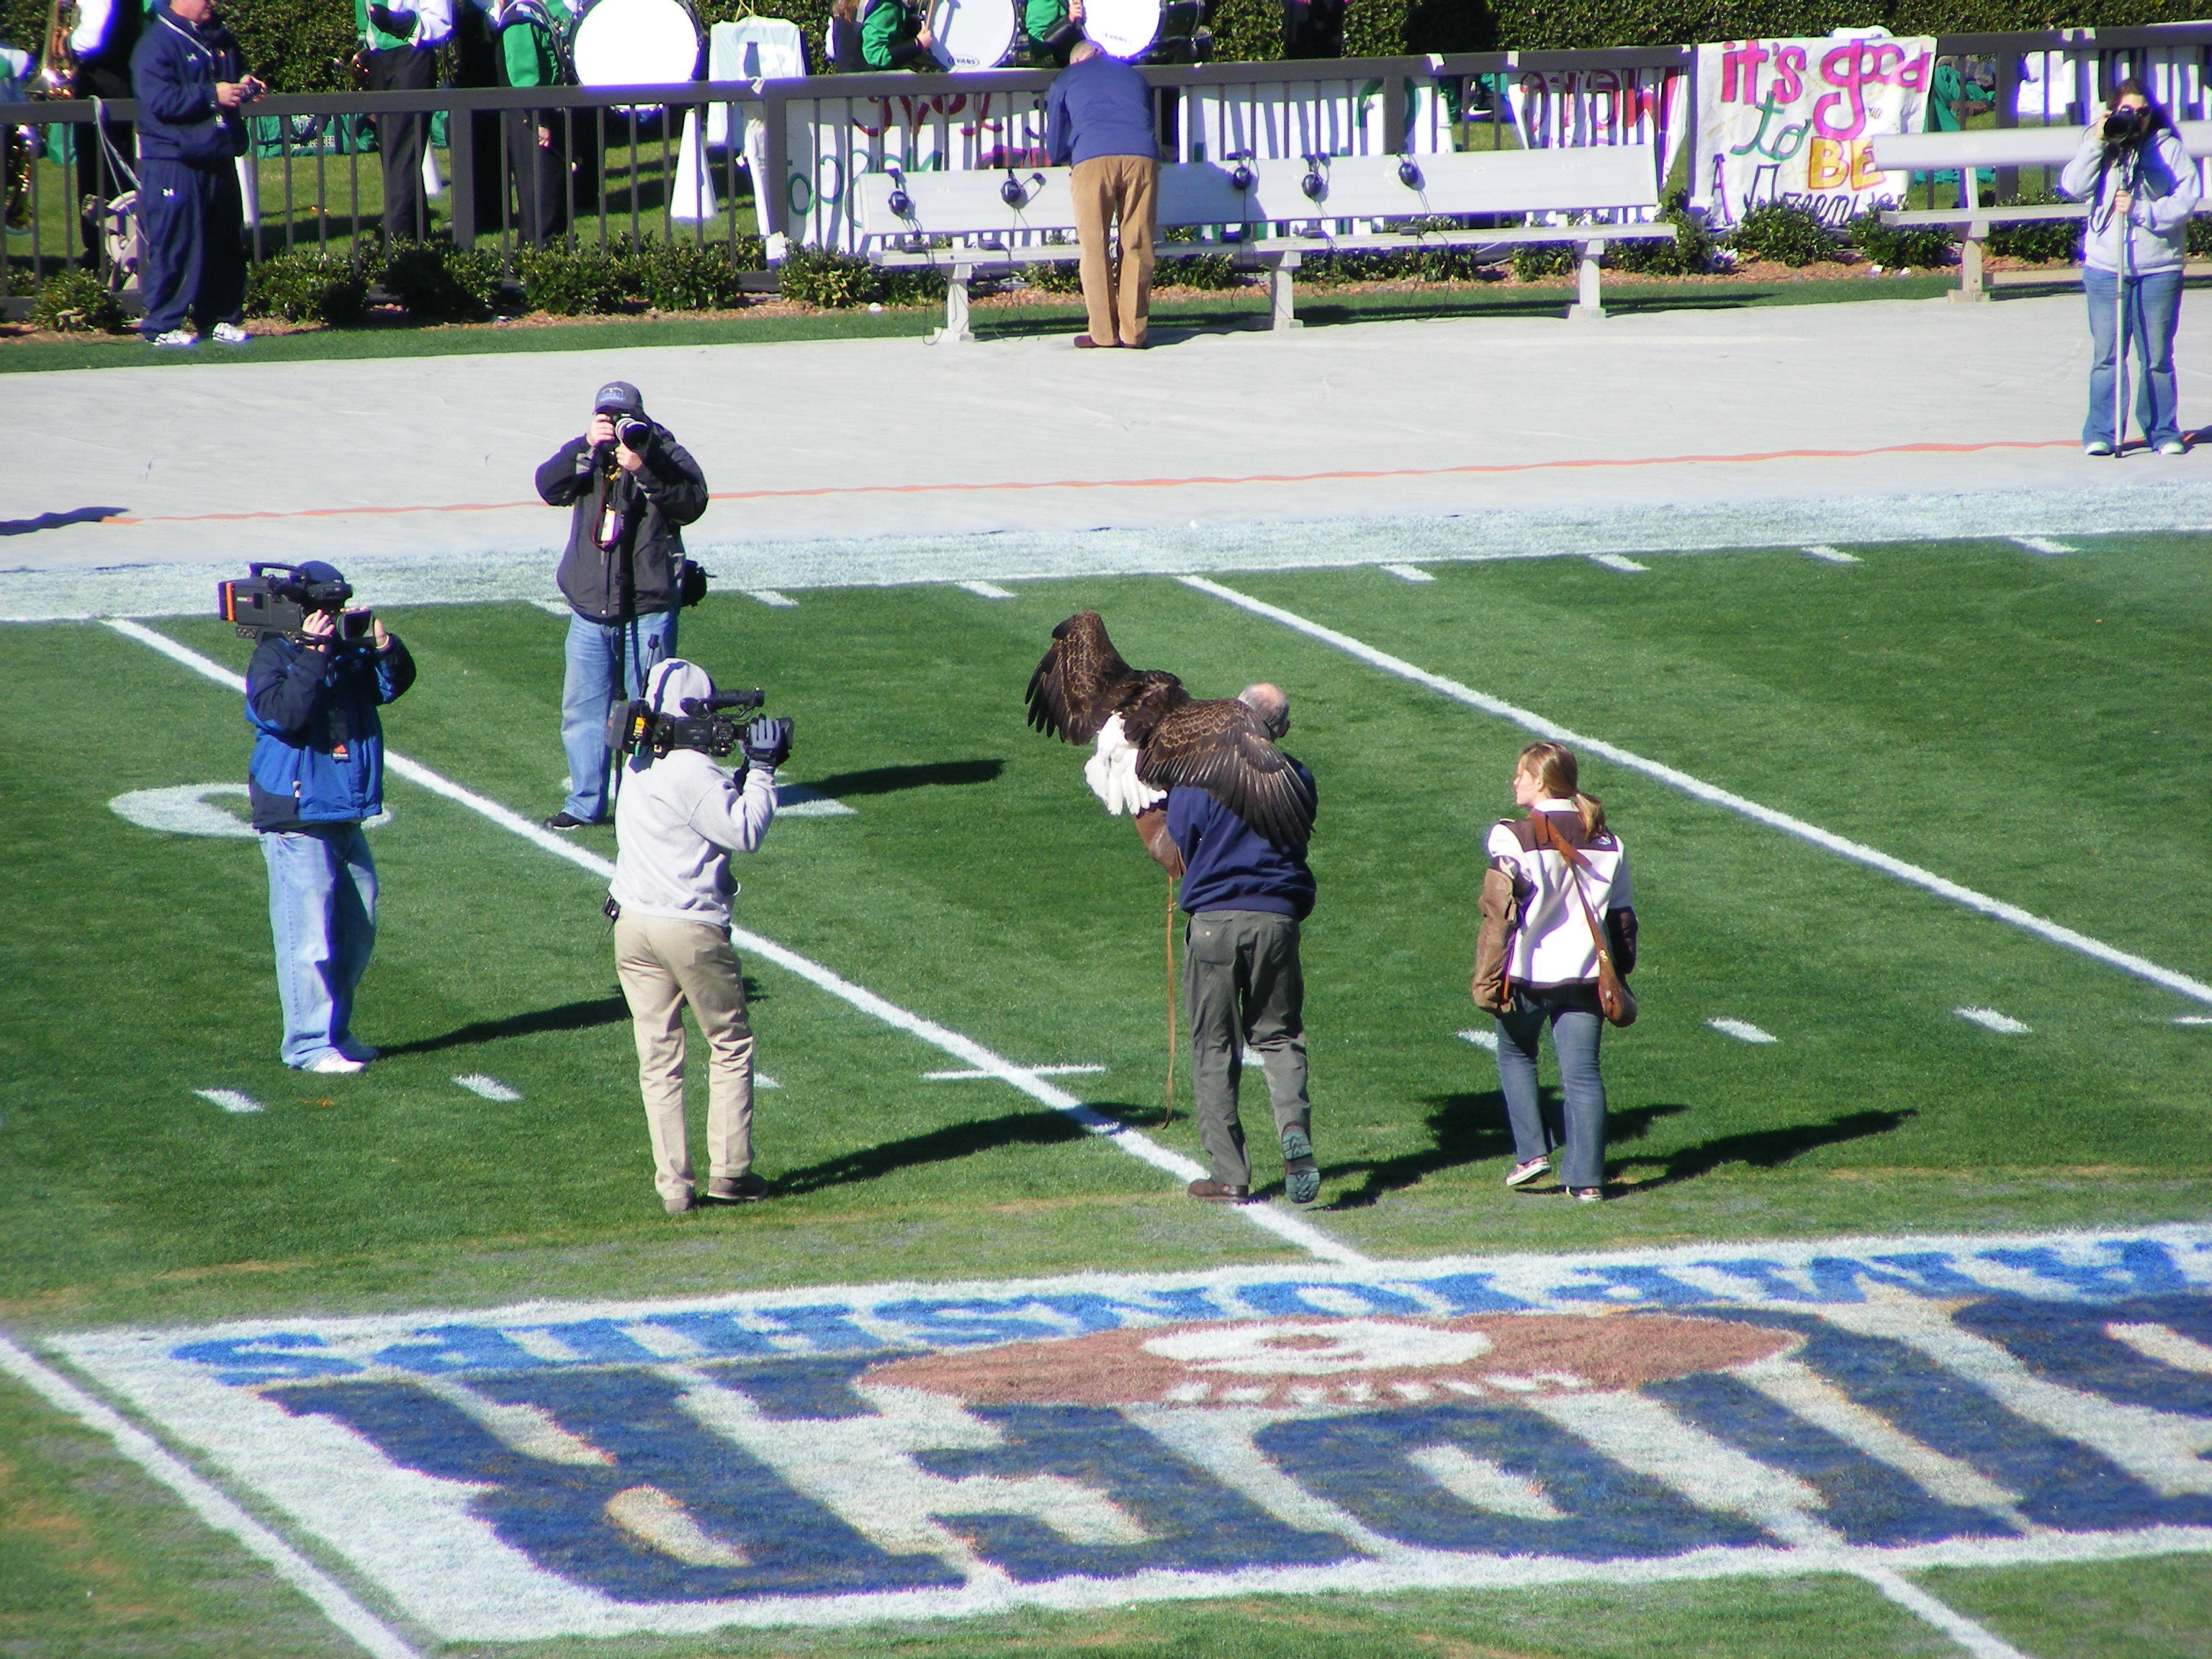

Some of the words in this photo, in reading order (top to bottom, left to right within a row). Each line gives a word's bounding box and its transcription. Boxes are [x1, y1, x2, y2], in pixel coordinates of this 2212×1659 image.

[1105, 32, 1128, 42] EVANS
[1721, 40, 1807, 106] it's
[1812, 39, 1931, 141] good
[1730, 89, 1813, 162] to
[1808, 135, 1887, 191] BE
